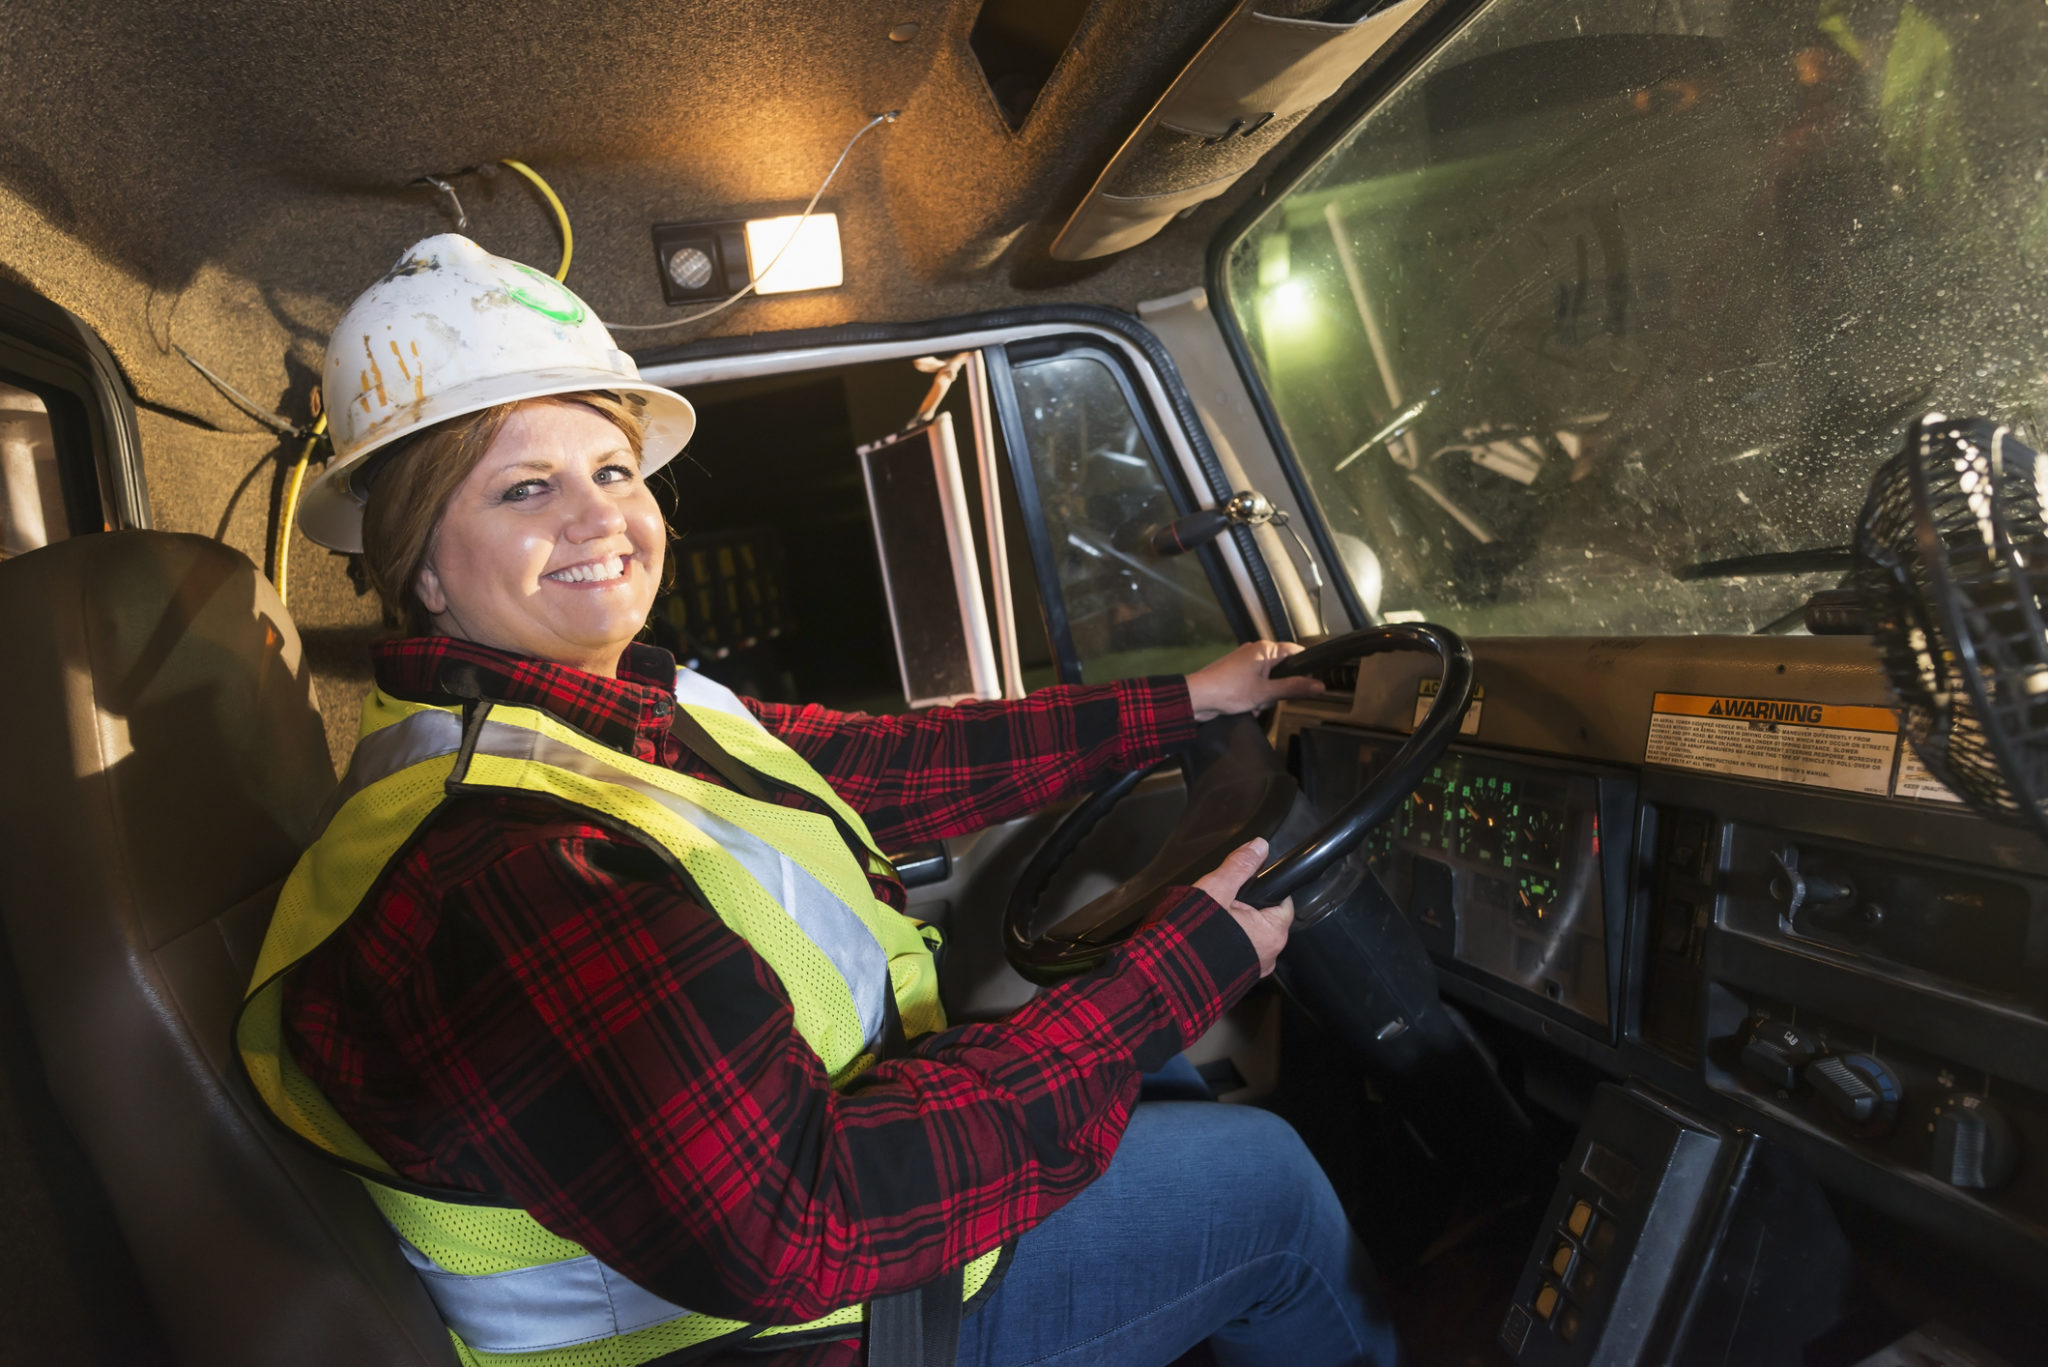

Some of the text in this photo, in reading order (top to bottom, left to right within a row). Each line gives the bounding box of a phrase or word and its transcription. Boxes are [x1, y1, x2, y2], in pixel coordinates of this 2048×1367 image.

[1725, 700, 1822, 723] WARNING
[1813, 732, 1852, 740] DIFFERENTLY
[1783, 1030, 1799, 1046] CAB
